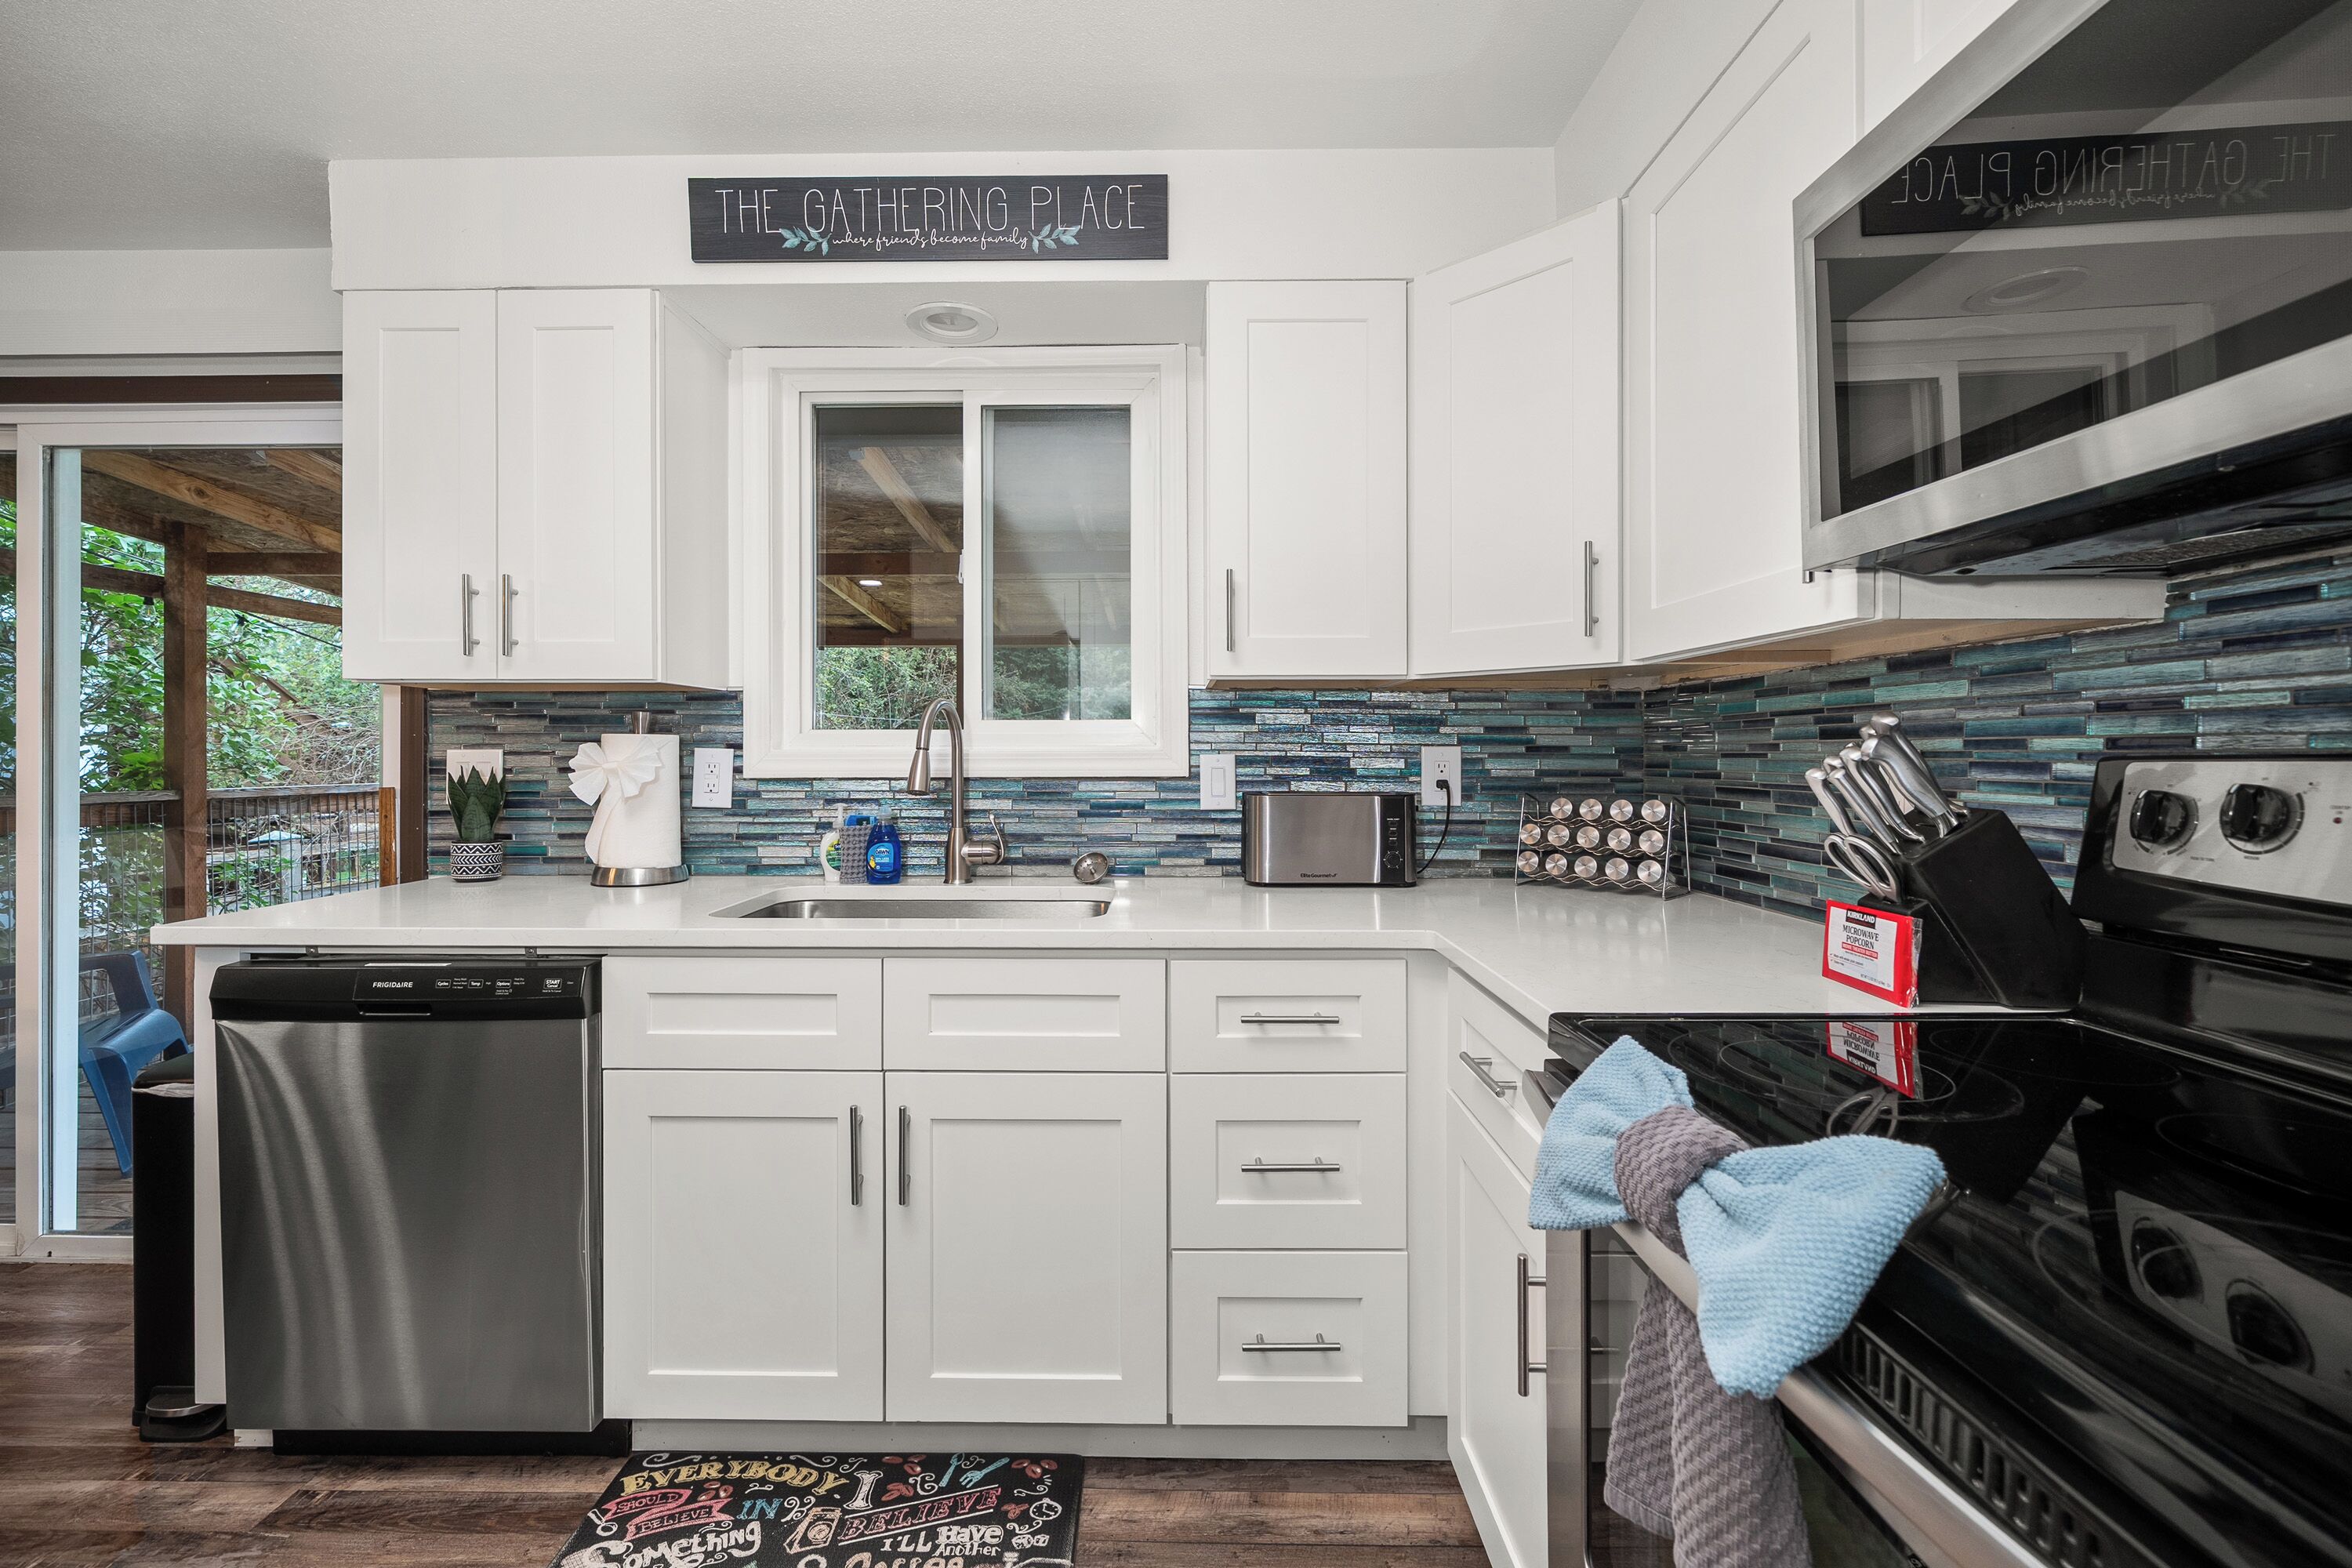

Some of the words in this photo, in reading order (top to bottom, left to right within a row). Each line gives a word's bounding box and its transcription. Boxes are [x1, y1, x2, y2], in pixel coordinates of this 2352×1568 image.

[714, 188, 782, 234] THE
[803, 186, 1007, 233] GATHERING
[1030, 184, 1145, 230] PLACE
[832, 231, 875, 247] where
[875, 227, 929, 252] friends
[930, 227, 979, 245] become
[980, 227, 1029, 251] family
[1846, 909, 1875, 924] KIRKLAND
[1842, 924, 1879, 942] MICROWAVE
[1846, 935, 1875, 950] POPCORN
[619, 1459, 850, 1497] EVERYBODY
[843, 1470, 883, 1510] I
[616, 1491, 680, 1512] SHOULD
[736, 1497, 783, 1520] IN
[639, 1508, 710, 1534] BELIEVE
[837, 1486, 1001, 1541] BELIEVE
[880, 1530, 933, 1552] I'LL
[935, 1525, 1004, 1544] Have
[931, 1542, 1001, 1556] Another
